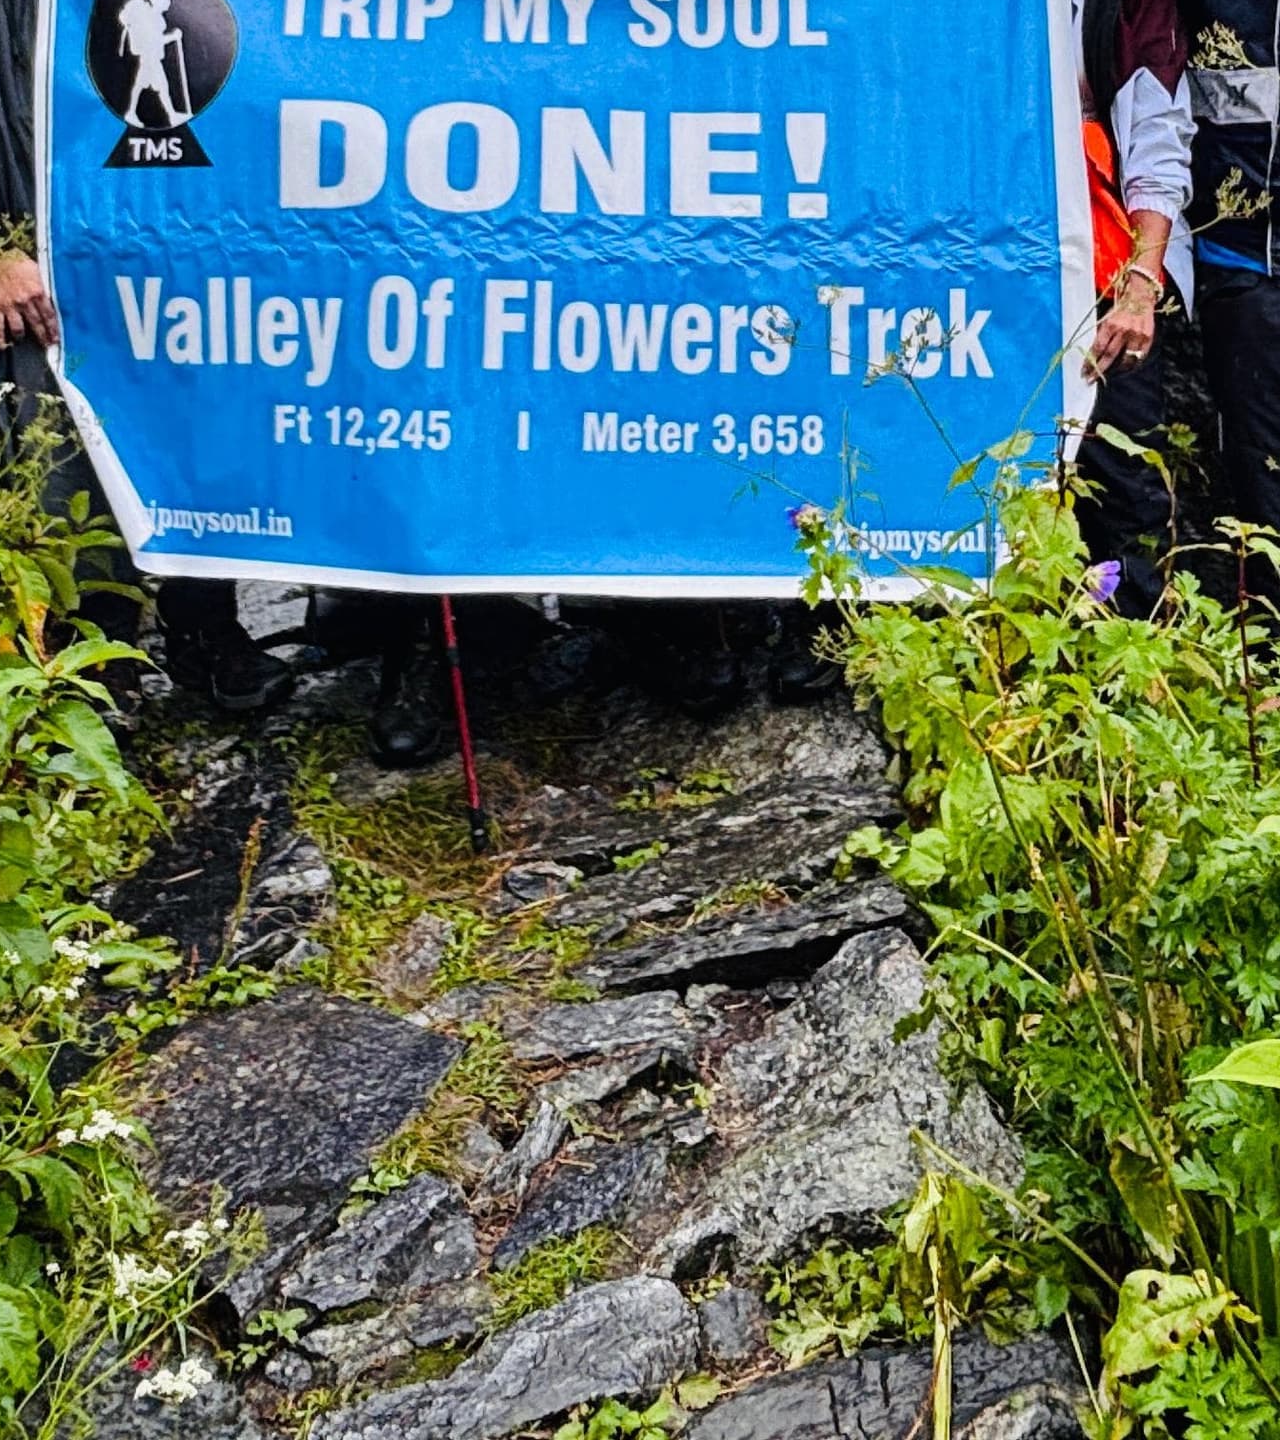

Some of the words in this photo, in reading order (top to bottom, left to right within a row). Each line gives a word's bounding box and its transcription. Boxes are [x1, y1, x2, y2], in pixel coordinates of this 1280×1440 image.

[128, 137, 184, 161] TMS
[279, 98, 828, 219] DONE!
[115, 275, 343, 387] Valley
[367, 274, 455, 371] Of
[482, 279, 792, 375] Flowers
[816, 285, 994, 378] Trek
[274, 405, 312, 444] Ft
[325, 406, 452, 455] 12,245
[582, 412, 700, 453] Meter
[712, 413, 825, 460] 3,658
